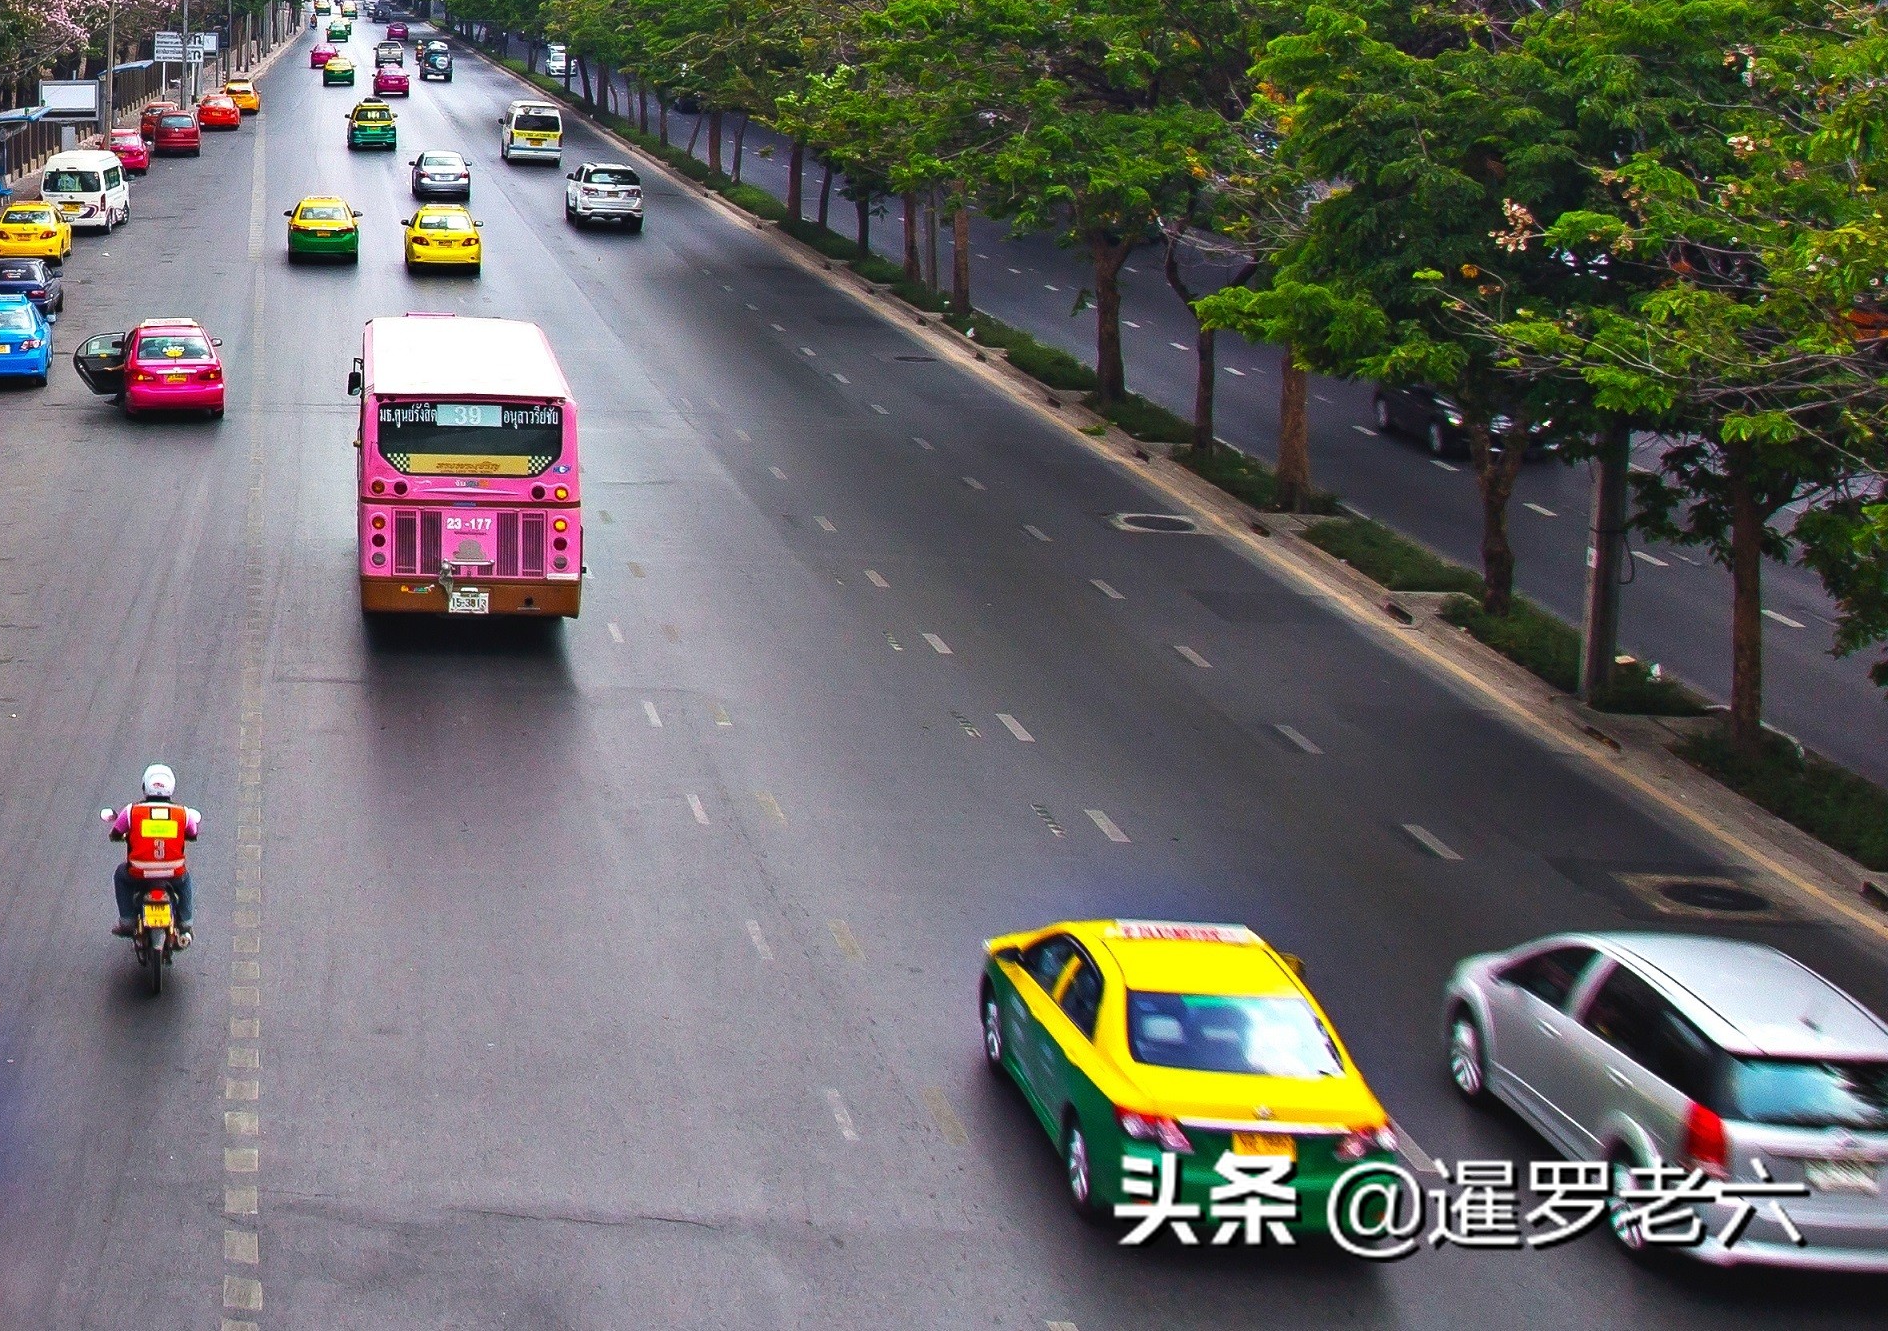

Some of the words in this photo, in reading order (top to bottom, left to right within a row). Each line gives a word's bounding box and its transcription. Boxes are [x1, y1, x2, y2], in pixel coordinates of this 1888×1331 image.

[454, 405, 482, 425] 39
[503, 405, 559, 430] อนุสาวรีย์ชัย
